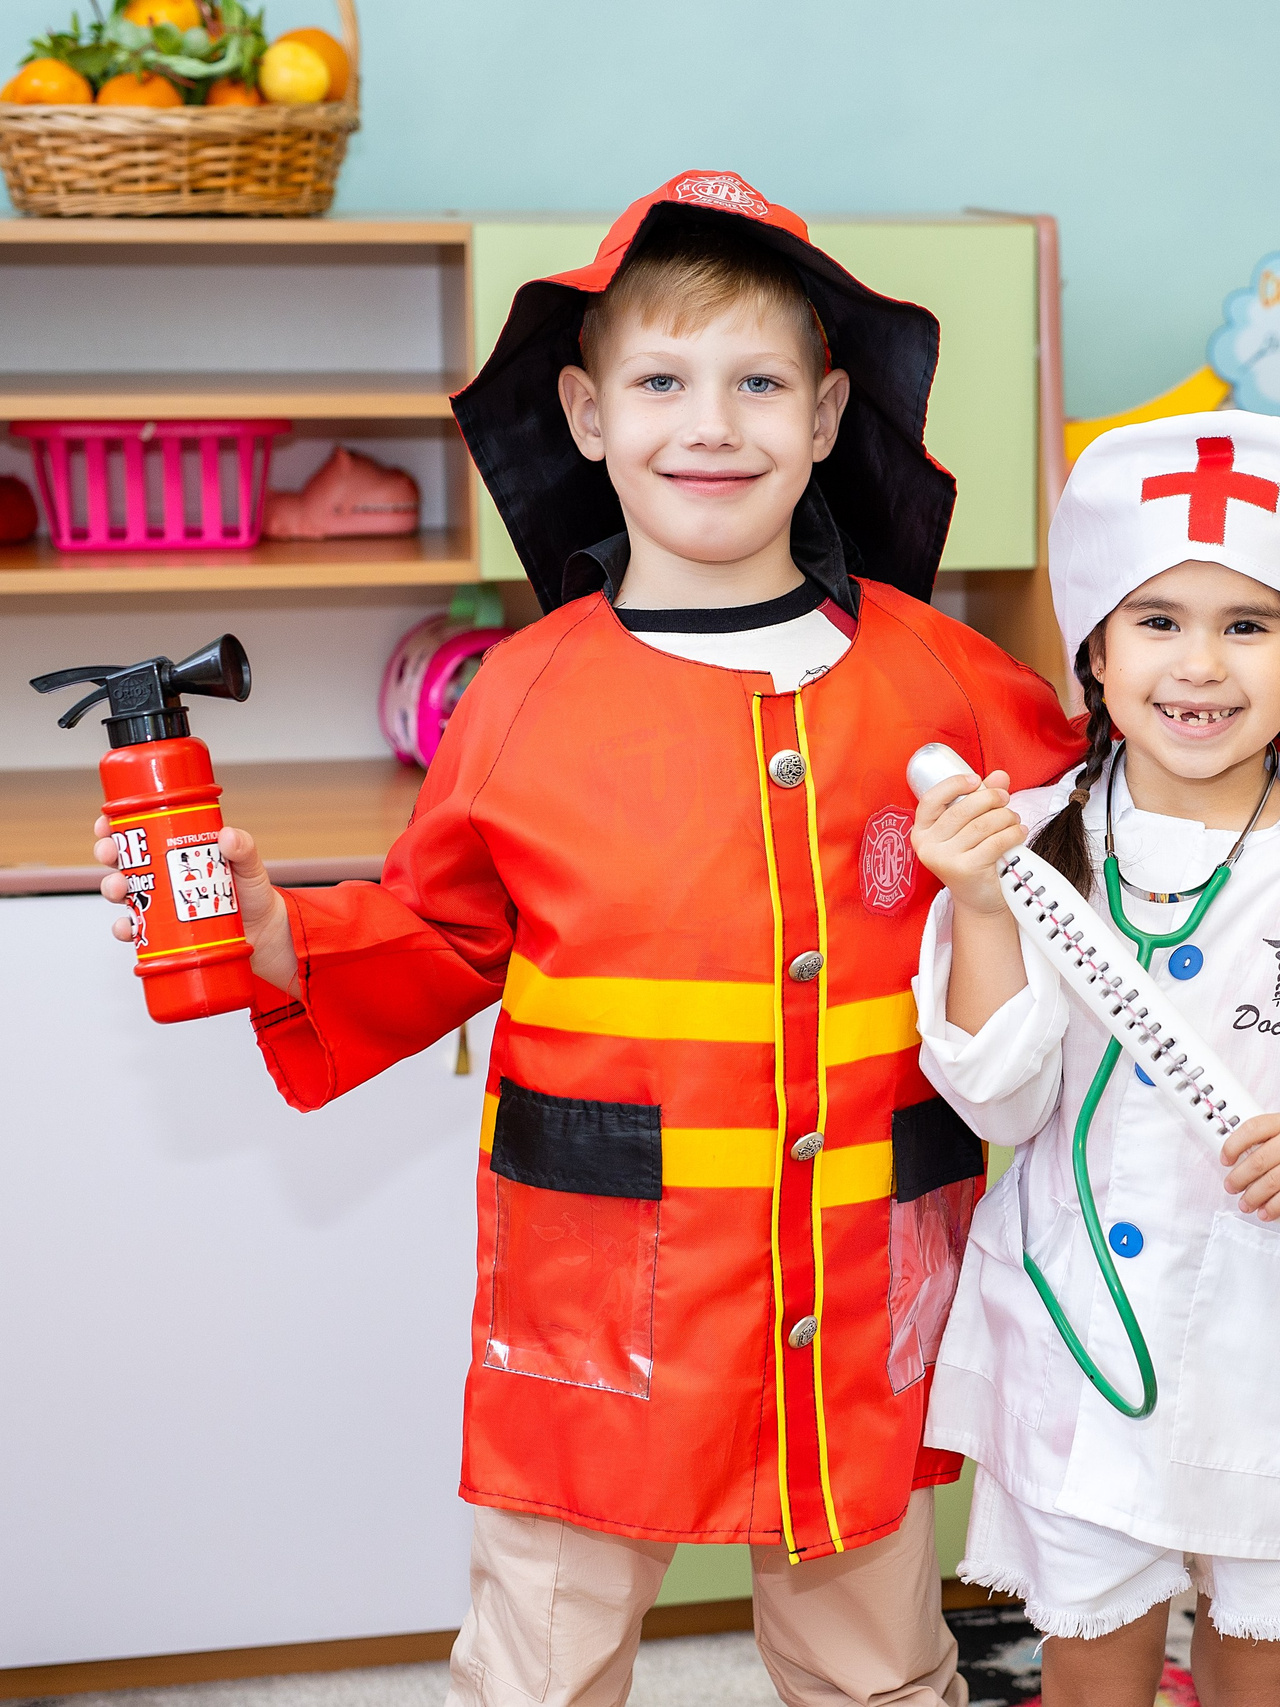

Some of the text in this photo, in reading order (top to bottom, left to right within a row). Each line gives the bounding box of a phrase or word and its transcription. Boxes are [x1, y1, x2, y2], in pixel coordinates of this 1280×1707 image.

[880, 818, 897, 829] FIRE
[111, 828, 151, 870] RE
[125, 873, 155, 893] sher
